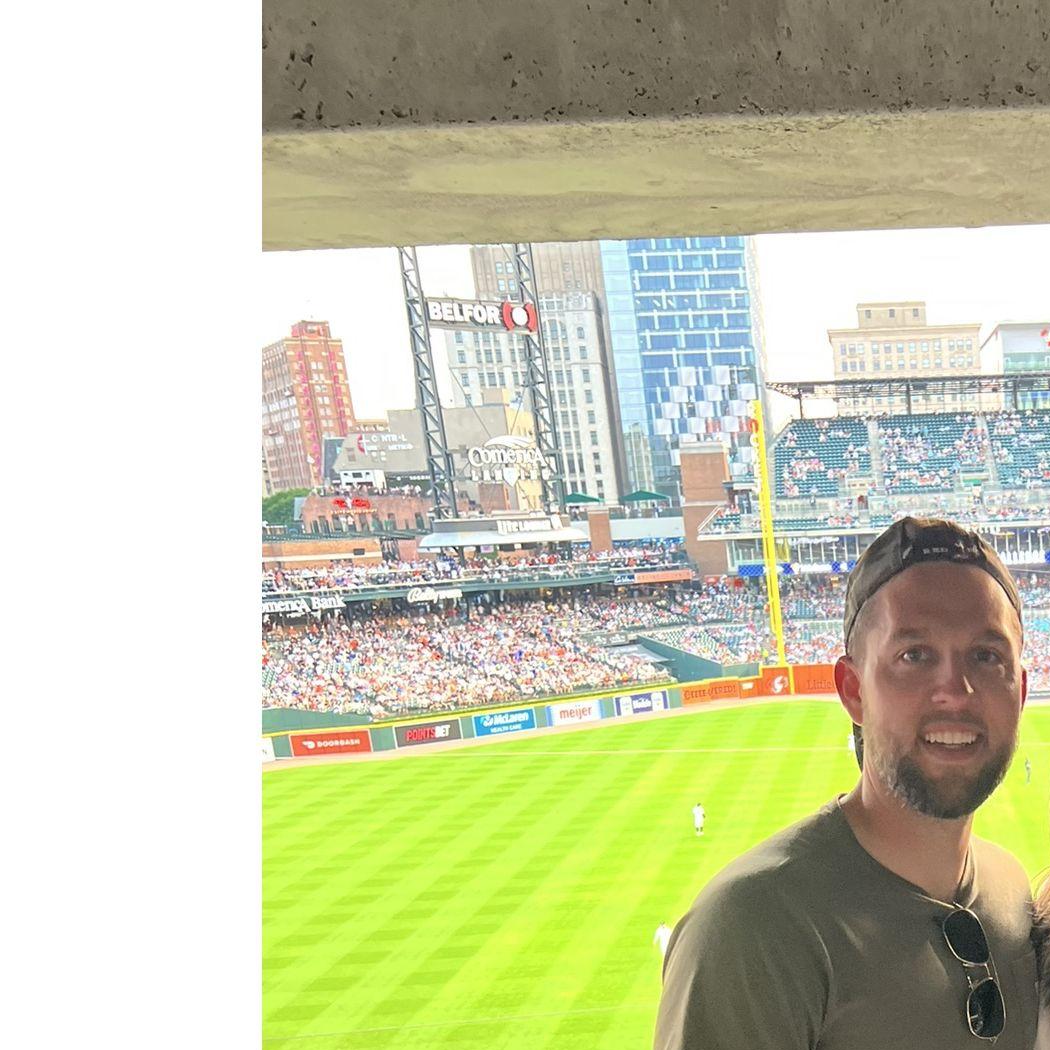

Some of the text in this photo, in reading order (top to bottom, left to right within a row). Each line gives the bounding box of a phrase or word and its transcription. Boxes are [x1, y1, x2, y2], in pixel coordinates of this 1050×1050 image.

[427, 301, 501, 324] BELFOR
[311, 594, 346, 611] Bank
[494, 712, 529, 726] McLaren
[560, 705, 592, 719] meijer
[406, 724, 450, 741] POINTSBET
[317, 738, 360, 748] DOORDASH
